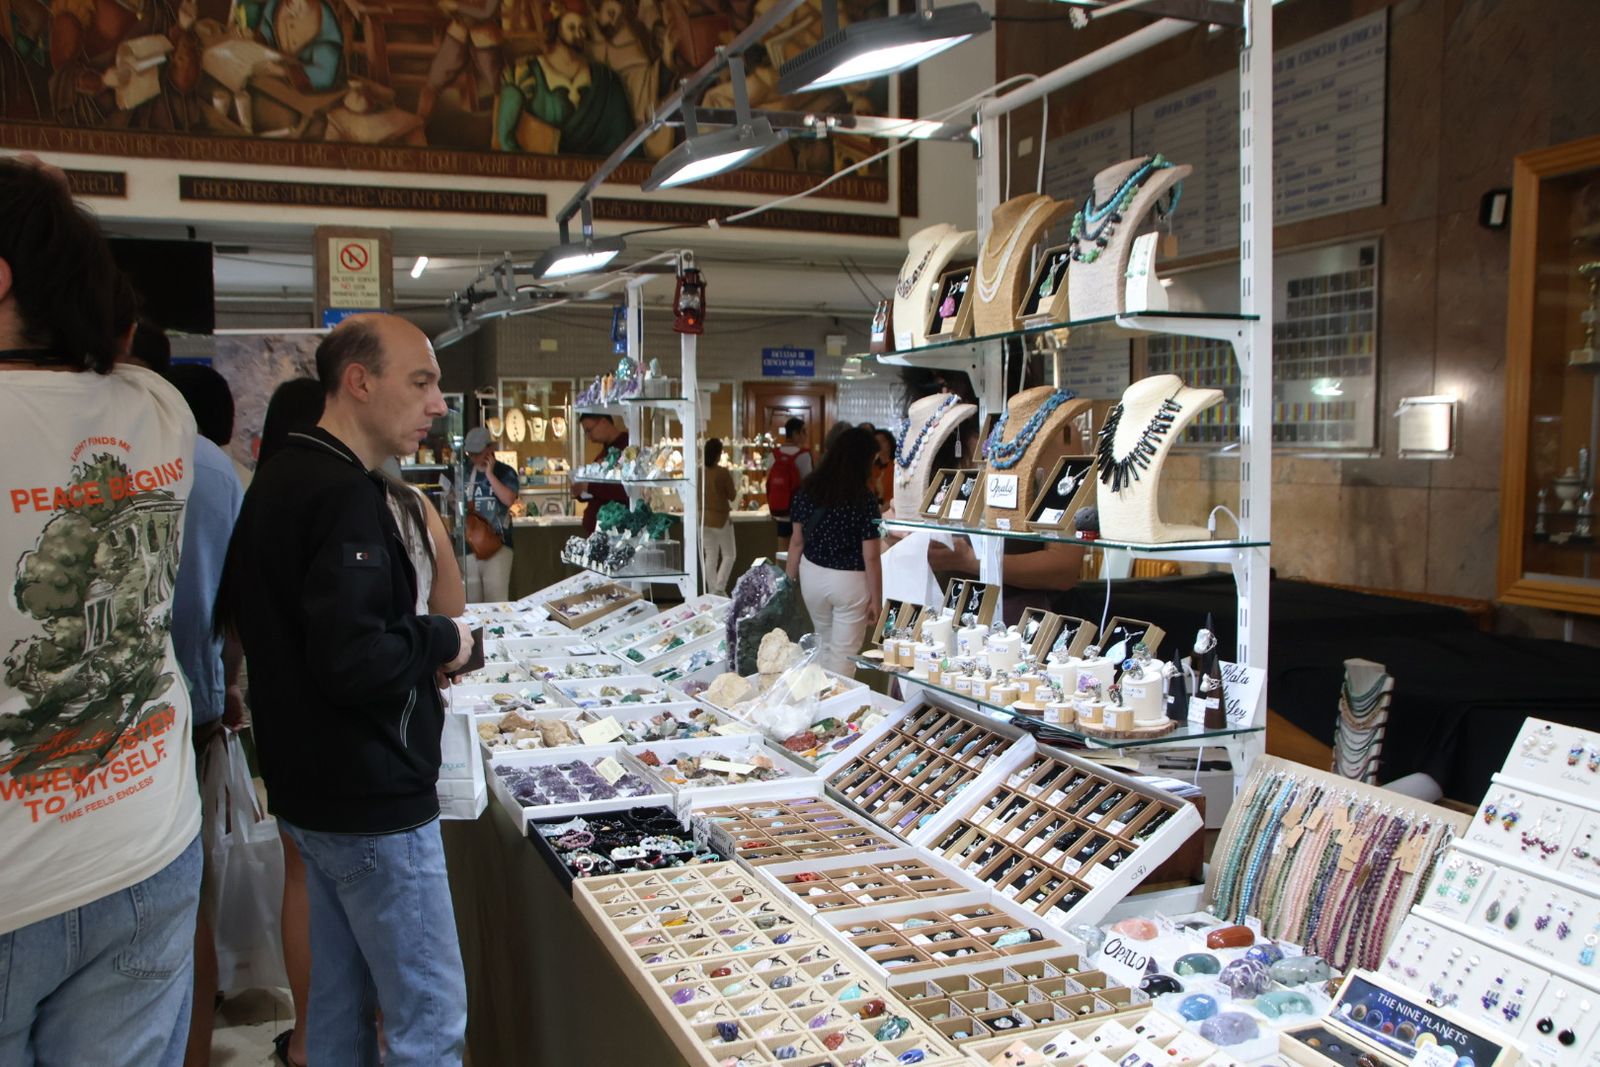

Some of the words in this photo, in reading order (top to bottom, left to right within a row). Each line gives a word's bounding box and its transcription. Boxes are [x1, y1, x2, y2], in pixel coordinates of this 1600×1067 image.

[88, 436, 117, 446] FINDS
[118, 438, 132, 453] ME
[10, 481, 104, 513] PEACE
[108, 456, 184, 502] BEGINS
[1222, 664, 1250, 685] Plata
[1226, 699, 1247, 722] Ley
[0, 764, 91, 801] WHEN
[107, 705, 177, 762] LISTEN
[24, 795, 66, 823] TO
[58, 808, 84, 824] TIME
[84, 795, 116, 813] FEELS
[116, 776, 155, 801] ENDLESS
[1103, 937, 1147, 971] OPALO
[1377, 992, 1398, 1010] THE
[1395, 1002, 1422, 1022] NINE
[1420, 1015, 1470, 1046] PLANETS
